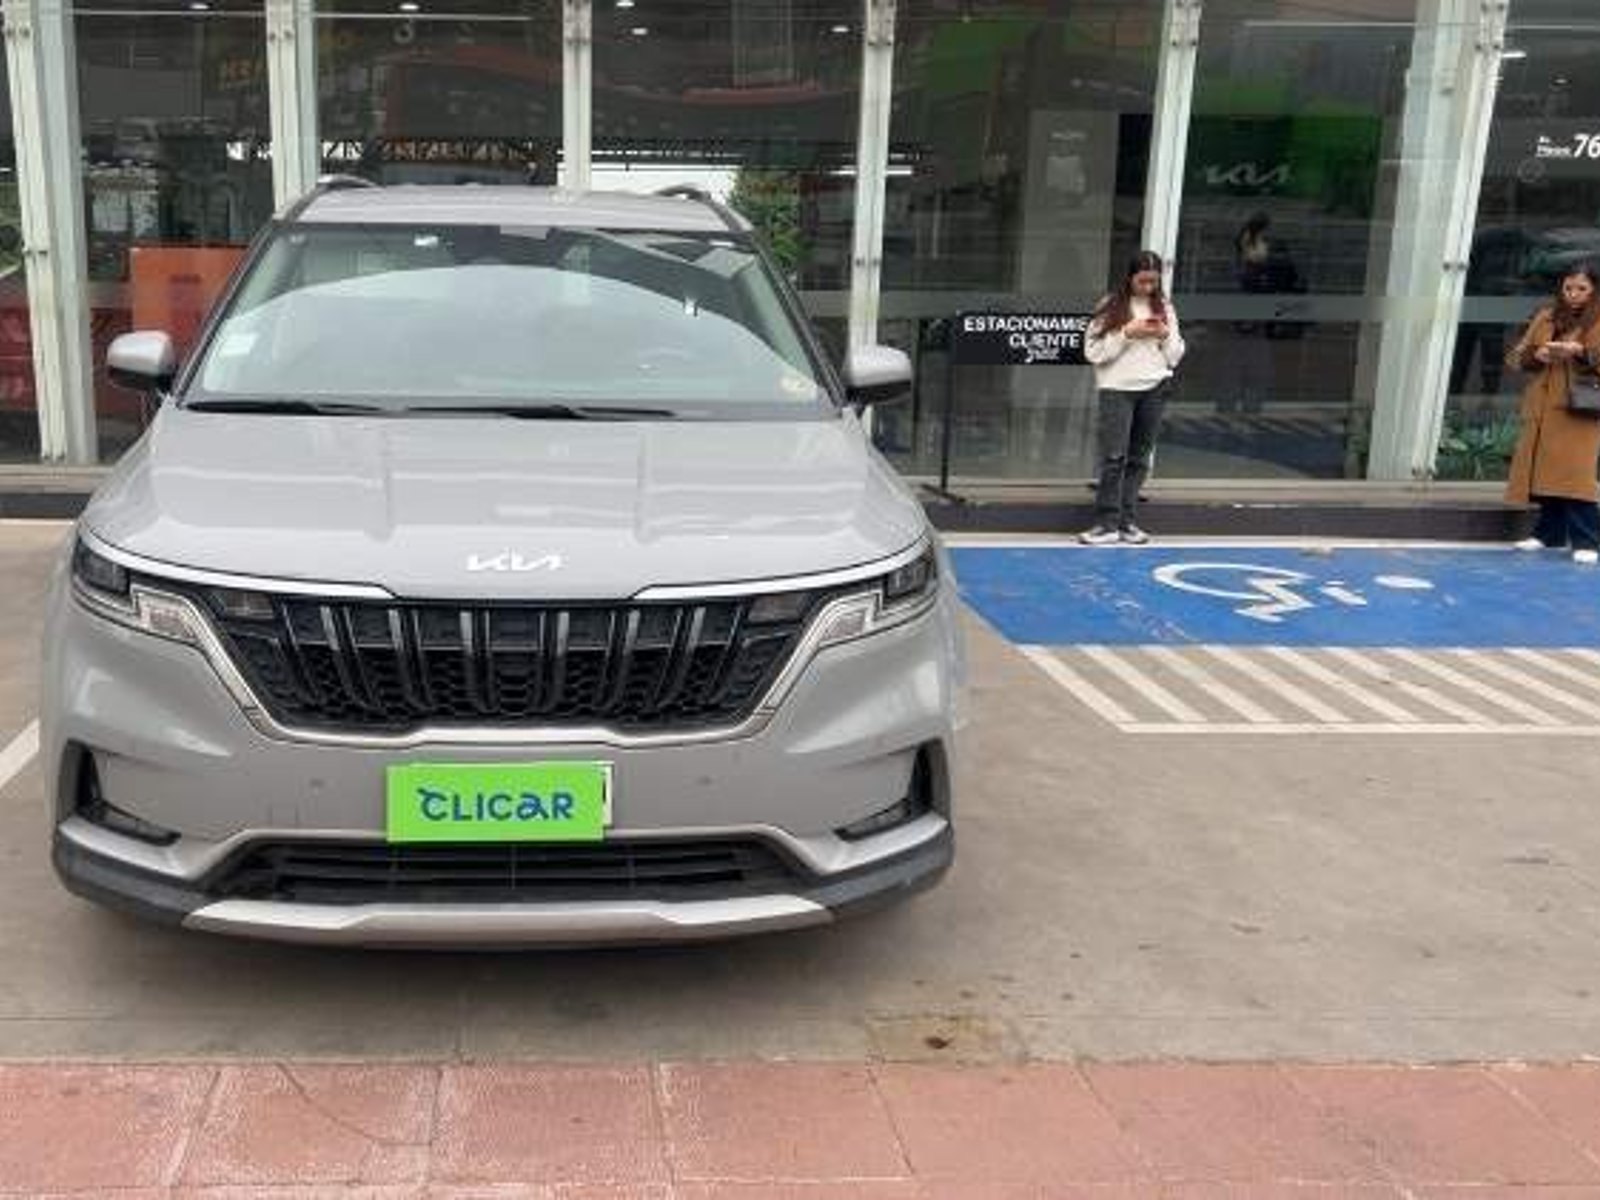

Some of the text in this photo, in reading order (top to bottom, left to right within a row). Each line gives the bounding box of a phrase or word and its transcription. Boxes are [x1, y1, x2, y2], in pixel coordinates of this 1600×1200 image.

[963, 315, 1090, 332] ESTACIONAMIE
[1009, 333, 1081, 349] CLIENTE
[465, 548, 564, 572] KIA
